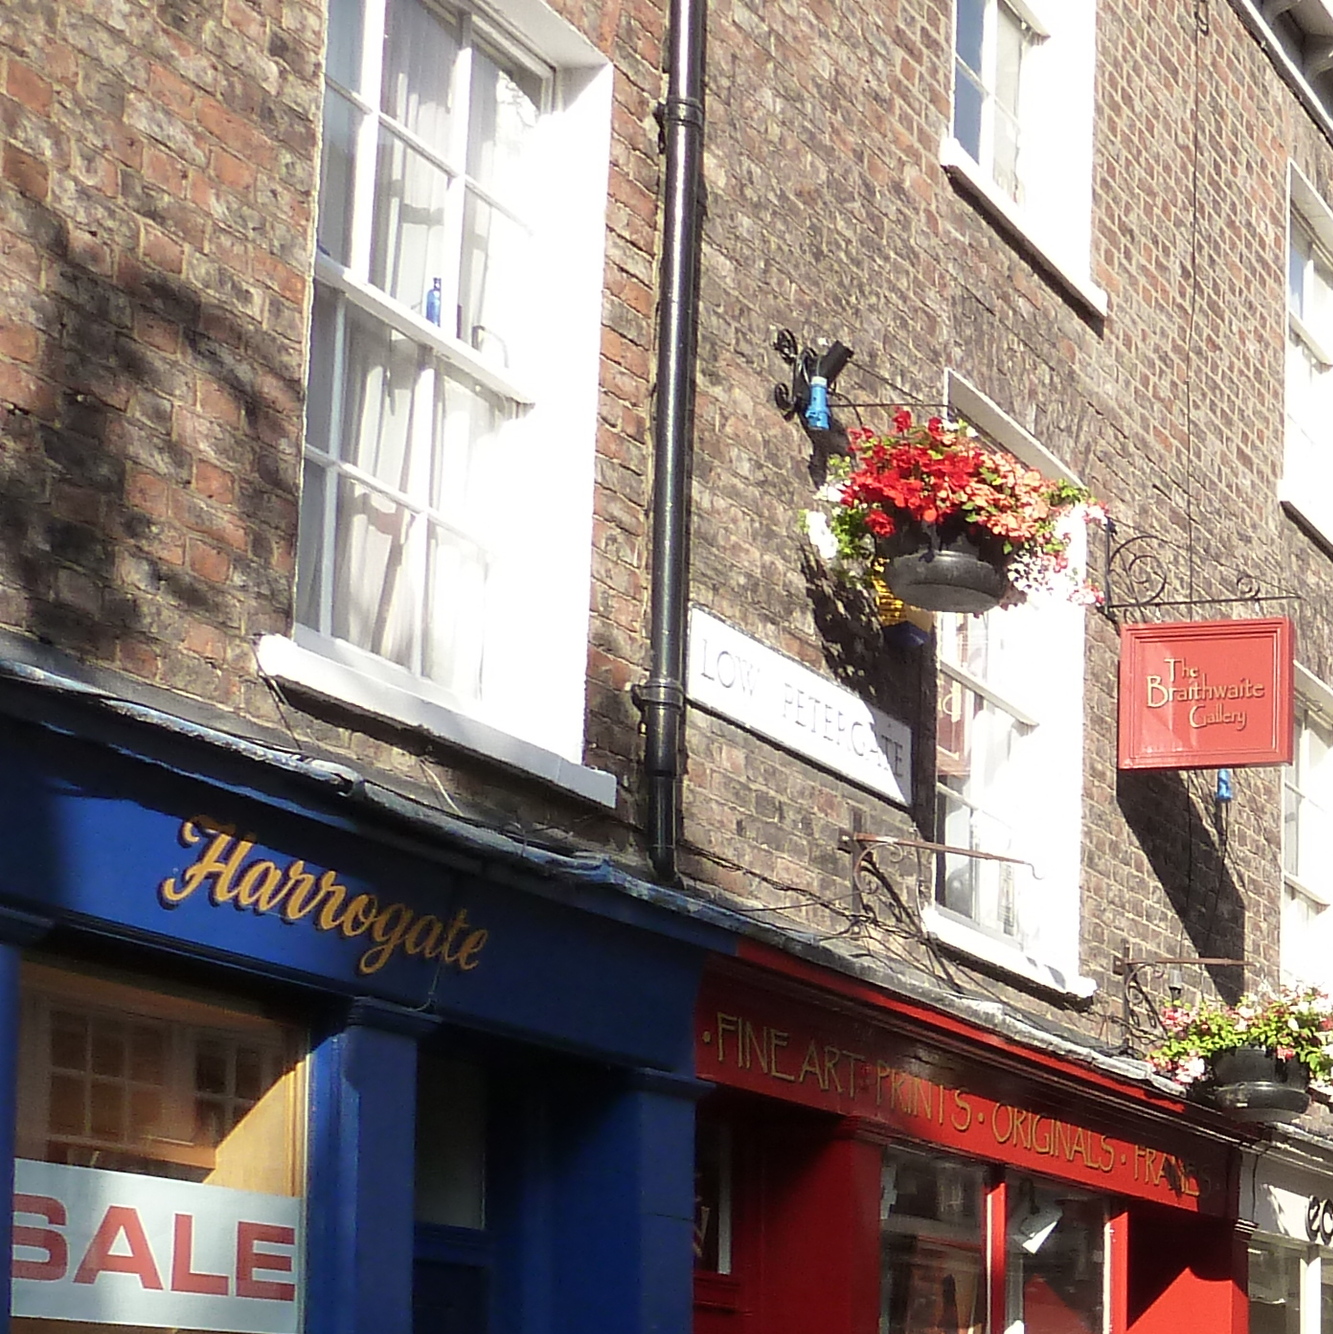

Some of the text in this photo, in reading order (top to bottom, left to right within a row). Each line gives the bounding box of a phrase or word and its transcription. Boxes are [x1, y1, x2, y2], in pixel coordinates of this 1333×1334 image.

[700, 638, 760, 697] LOW
[1146, 673, 1265, 708] Braithwaite
[1163, 658, 1199, 683] The
[1188, 703, 1247, 731] Gallery
[157, 815, 489, 975] Harrogate
[715, 1012, 795, 1083] FINE
[799, 1044, 866, 1099] ART
[875, 1064, 973, 1132] PRINTS
[991, 1100, 1117, 1173] ORIGINALS
[11, 1193, 296, 1301] SALE
